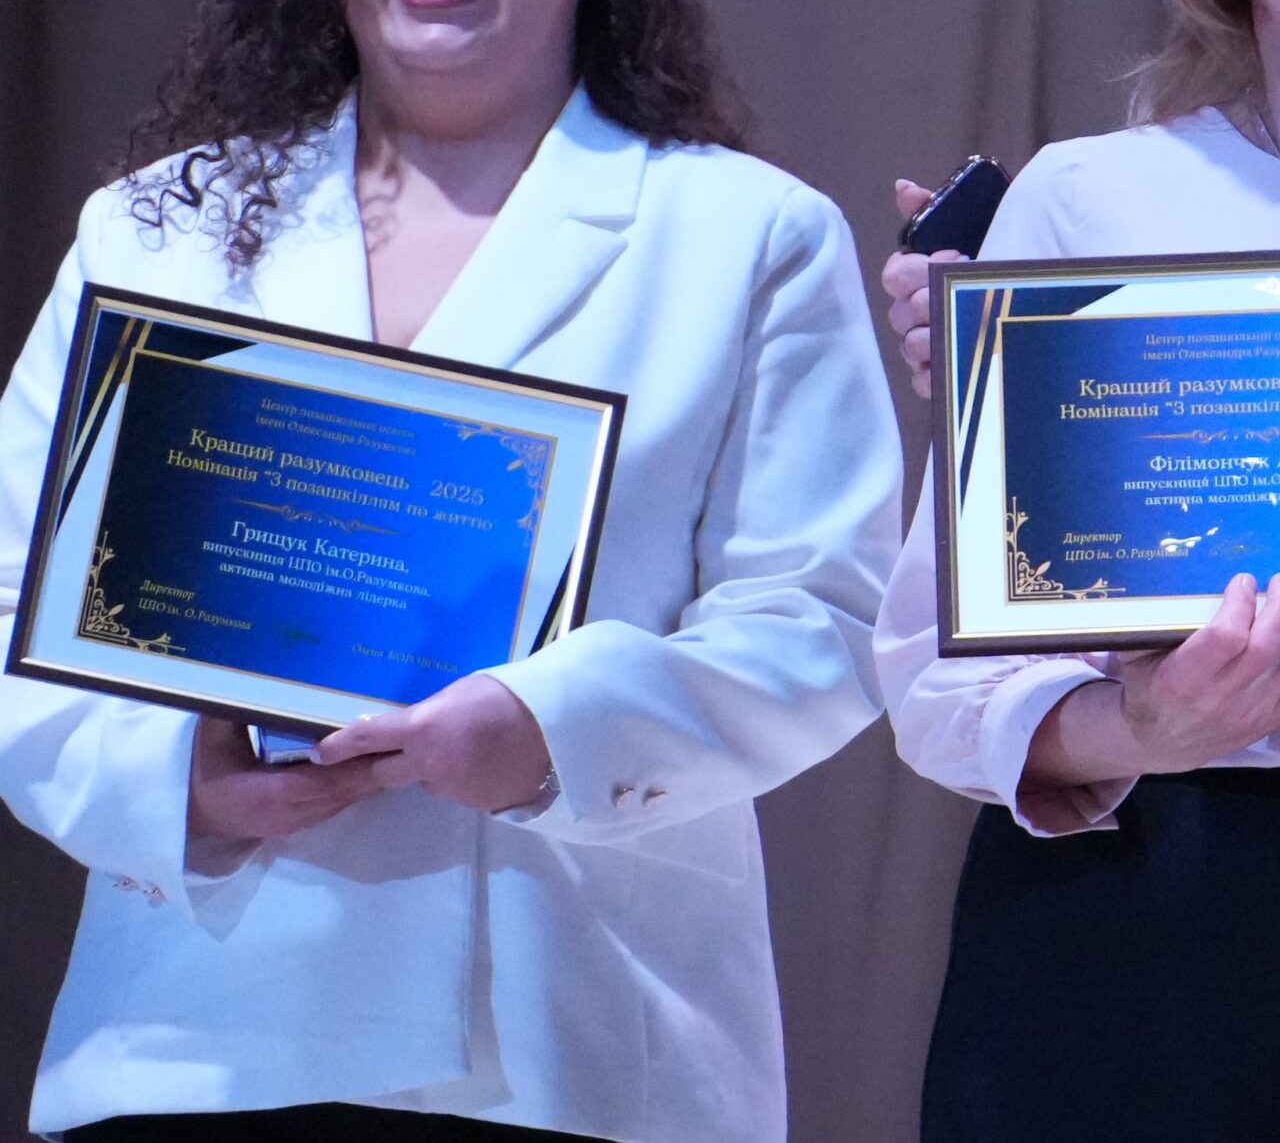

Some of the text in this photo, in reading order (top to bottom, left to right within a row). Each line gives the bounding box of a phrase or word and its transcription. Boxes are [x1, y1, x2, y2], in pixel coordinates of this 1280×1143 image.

[1079, 376, 1170, 399] Кращий
[1059, 400, 1158, 419] Номінація
[189, 429, 484, 504] Кращий разумковець 2025
[1149, 451, 1269, 475] Філімончук
[167, 450, 257, 479] Номінація
[286, 476, 400, 510] позашкіллям
[407, 503, 427, 515] по
[1123, 476, 1209, 491] випускниця
[1214, 474, 1249, 488] ЦПО
[1145, 495, 1202, 505] активна
[231, 521, 409, 573] Грищук Катерина,
[1062, 530, 1122, 545] Директор
[202, 541, 283, 566] випускниця
[287, 555, 323, 575] ЦПО
[1064, 549, 1095, 561] ЦПО
[1096, 548, 1112, 559] ім.
[140, 579, 194, 599] Директор
[219, 562, 406, 609] активна молодіжна лідерка
[137, 597, 167, 613] ЦПО
